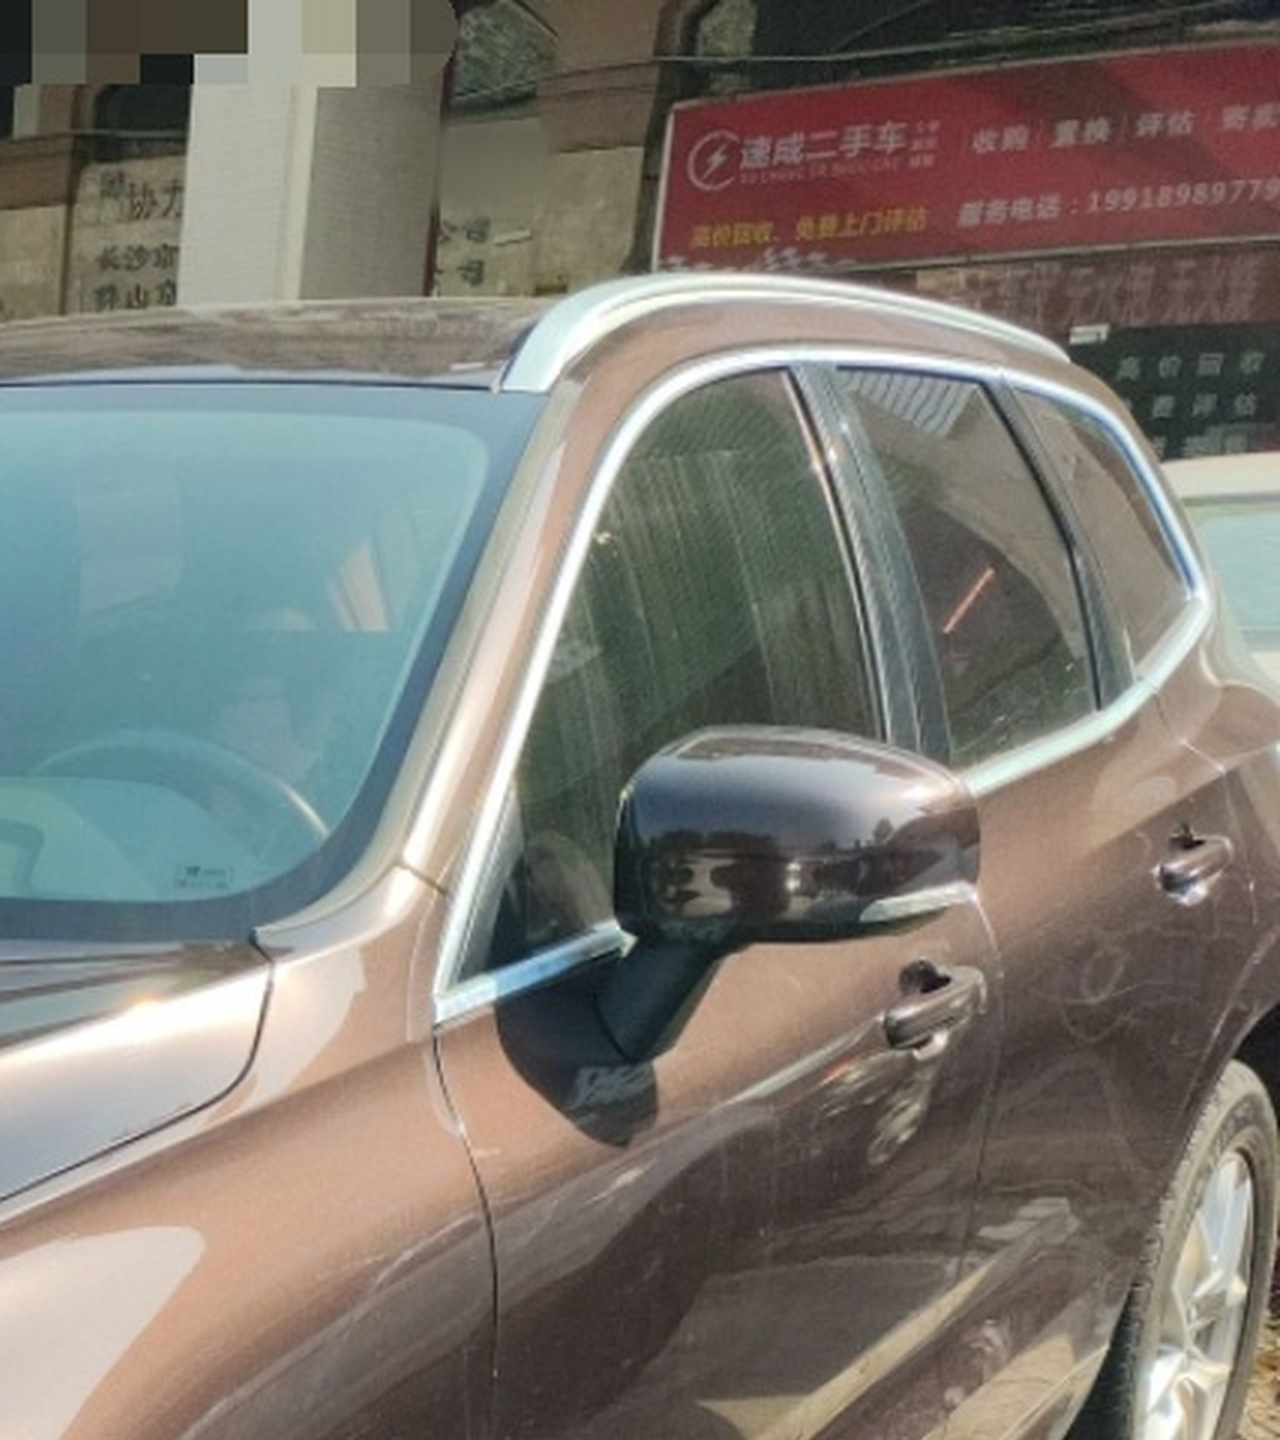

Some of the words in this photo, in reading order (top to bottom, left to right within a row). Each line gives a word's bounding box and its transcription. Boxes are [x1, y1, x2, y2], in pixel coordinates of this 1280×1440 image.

[972, 125, 1030, 154] 收购
[1052, 117, 1112, 148] 置换
[1137, 101, 1194, 137] 评估
